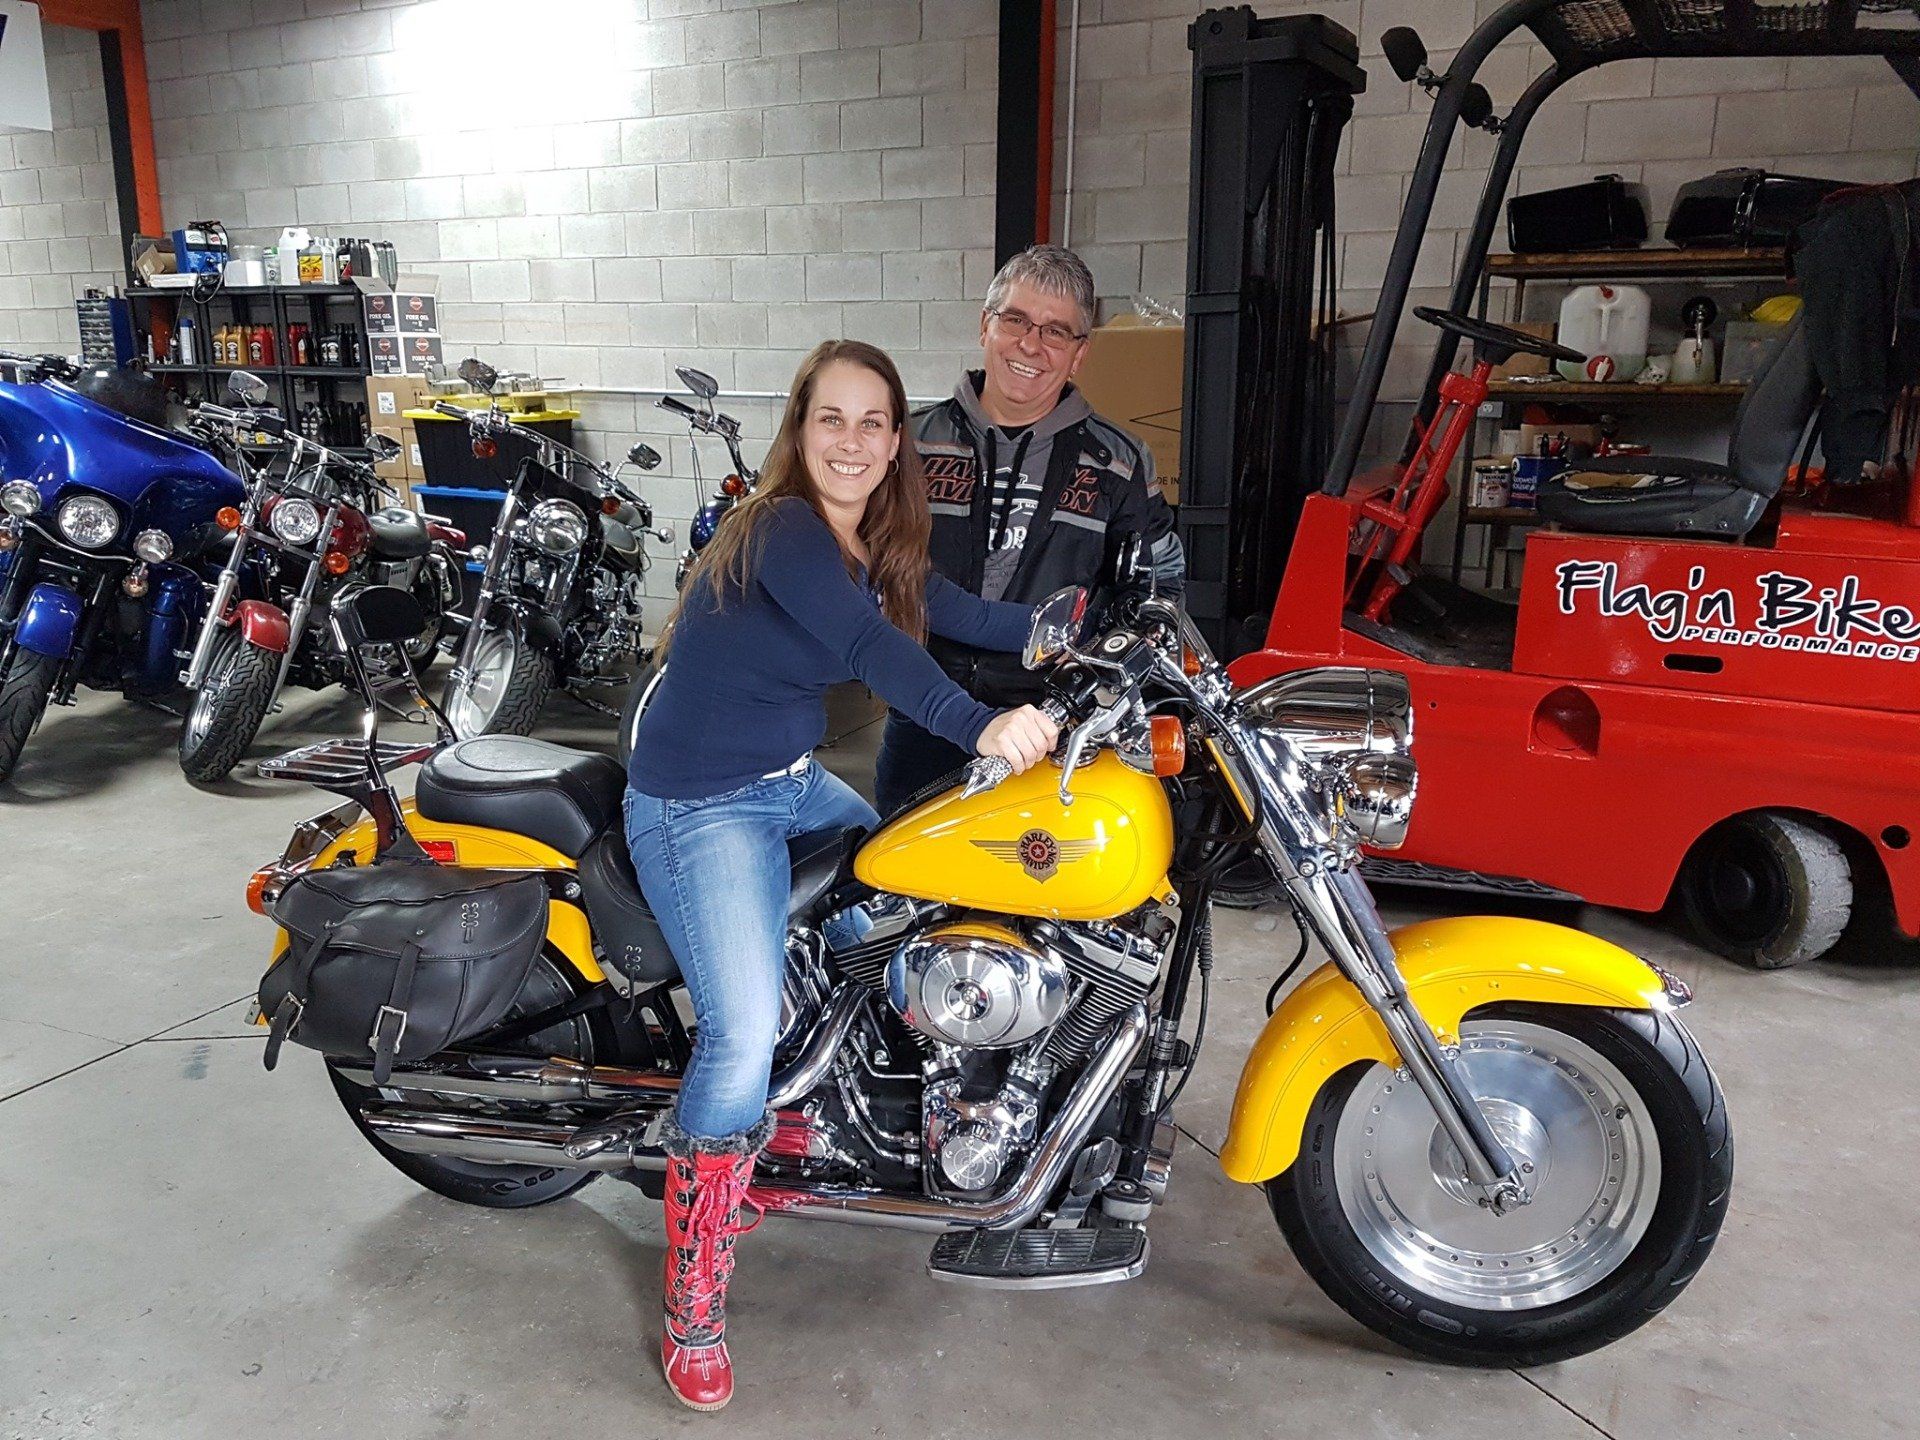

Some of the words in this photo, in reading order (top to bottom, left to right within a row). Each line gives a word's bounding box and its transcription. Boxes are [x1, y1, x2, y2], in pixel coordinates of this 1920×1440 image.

[1058, 488, 1098, 512] ON
[1555, 560, 1736, 643] Flag'n
[1755, 571, 1920, 643] Bike
[1681, 625, 1920, 663] PERFORMANCE
[1021, 832, 1056, 849] HARLEY
[1020, 851, 1056, 870] DAVIDSON
